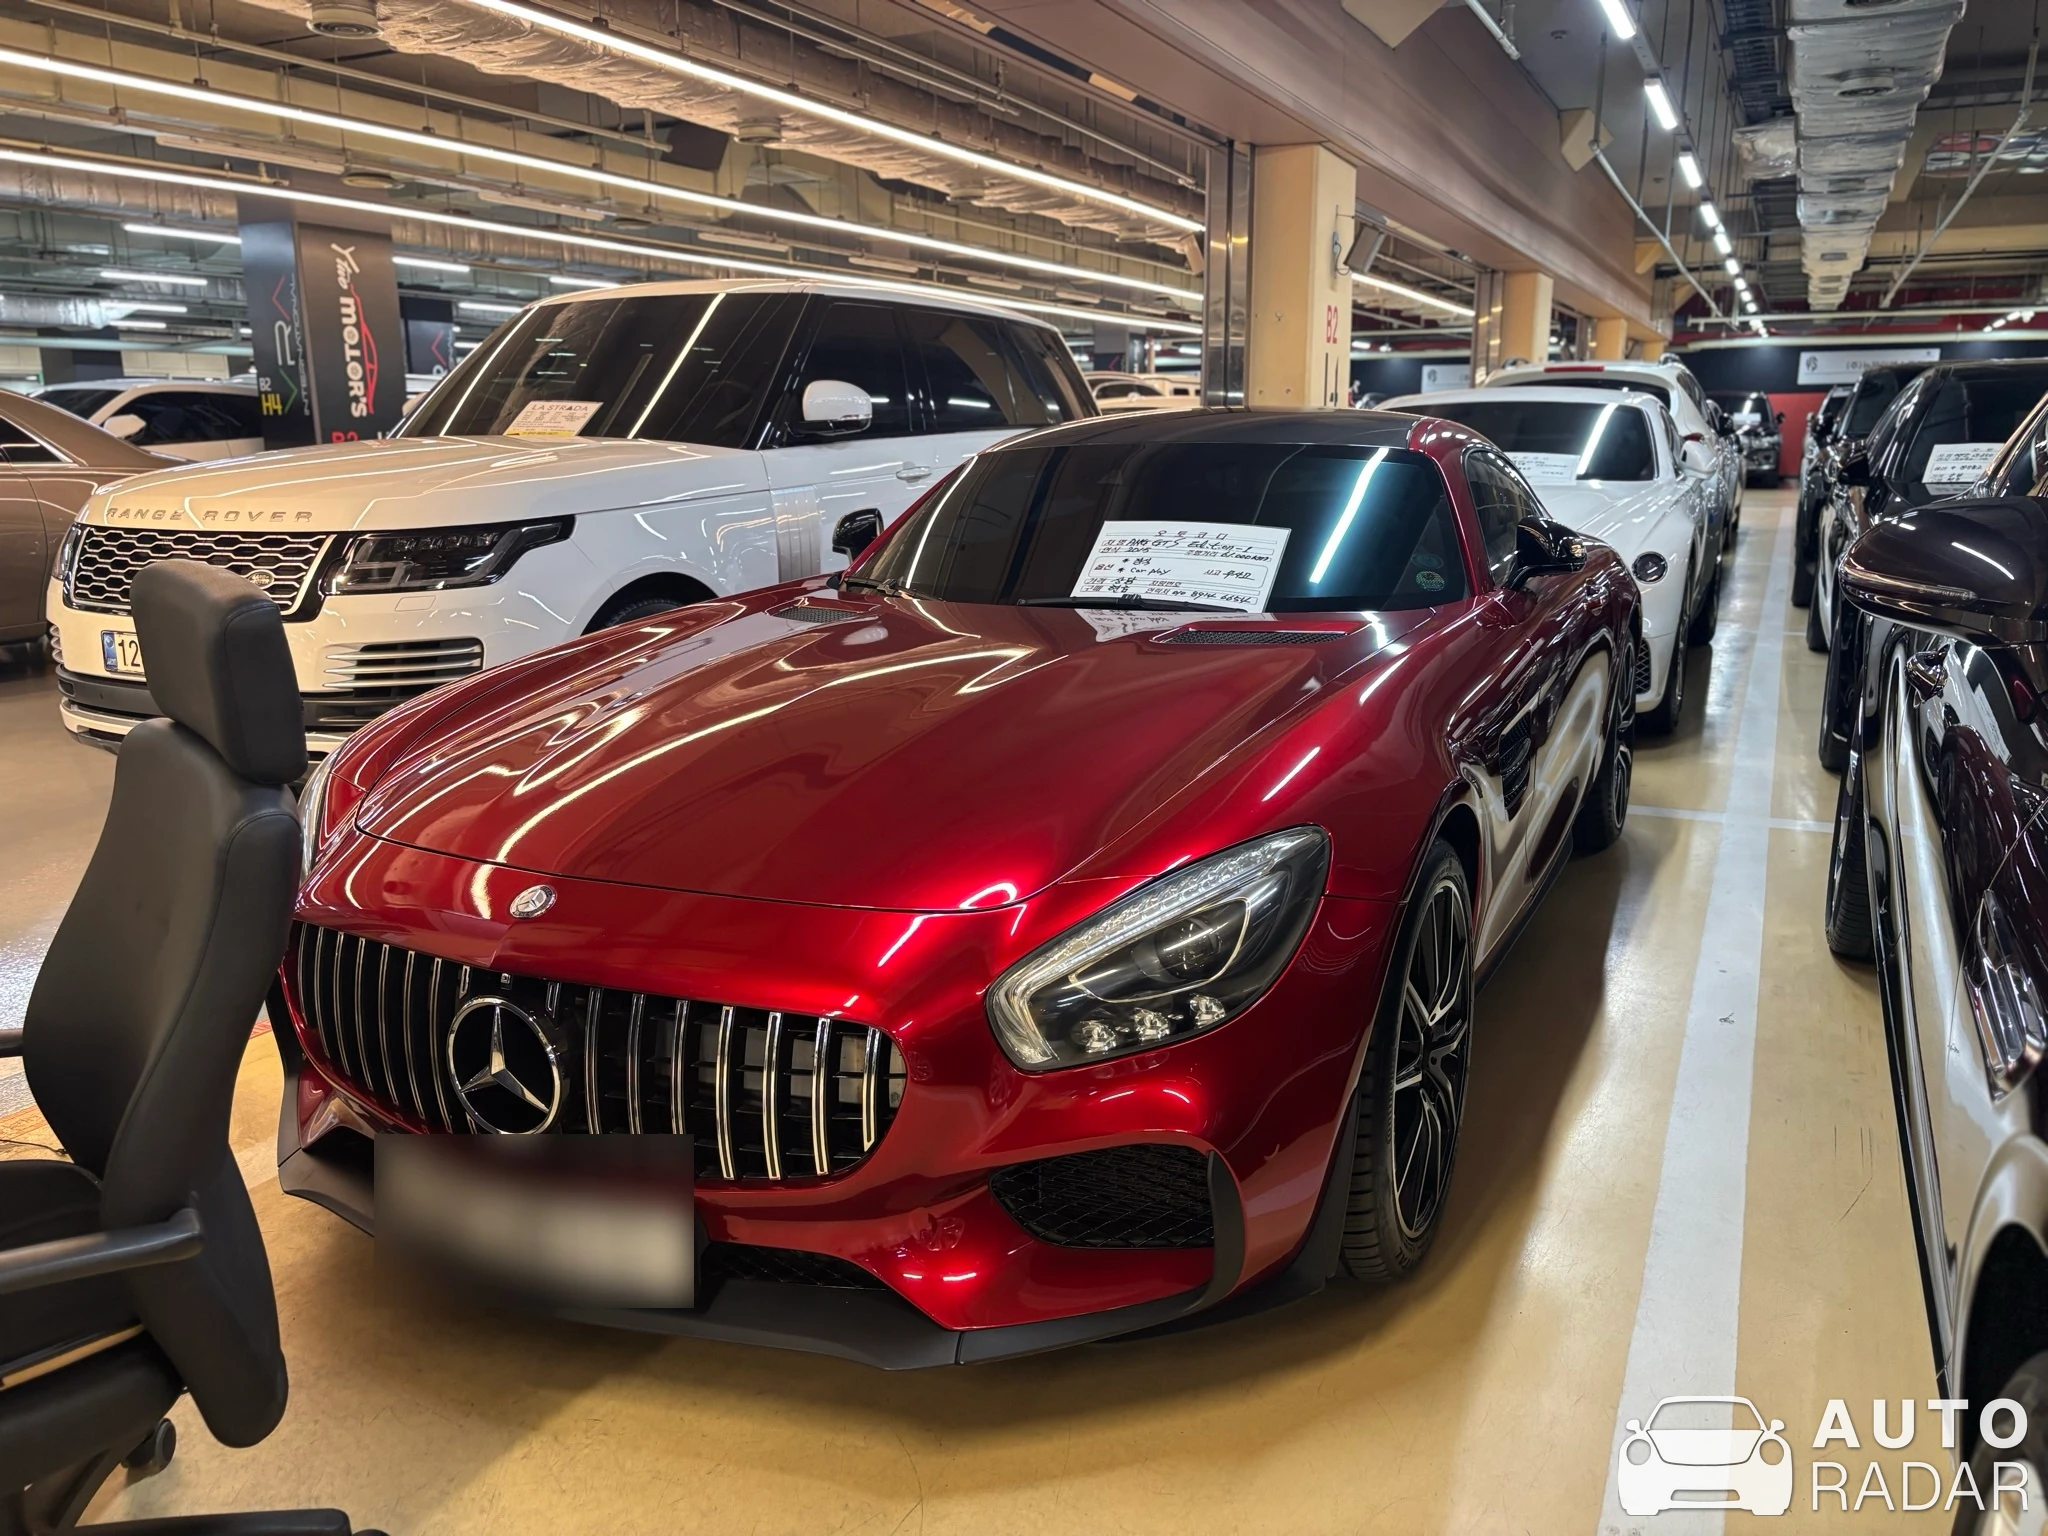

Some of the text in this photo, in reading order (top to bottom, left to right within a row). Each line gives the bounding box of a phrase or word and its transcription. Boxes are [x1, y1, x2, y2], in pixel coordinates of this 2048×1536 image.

[1326, 305, 1338, 344] B2
[259, 377, 272, 391] B2
[261, 393, 283, 416] H4
[105, 507, 313, 522] RANGE ROVER
